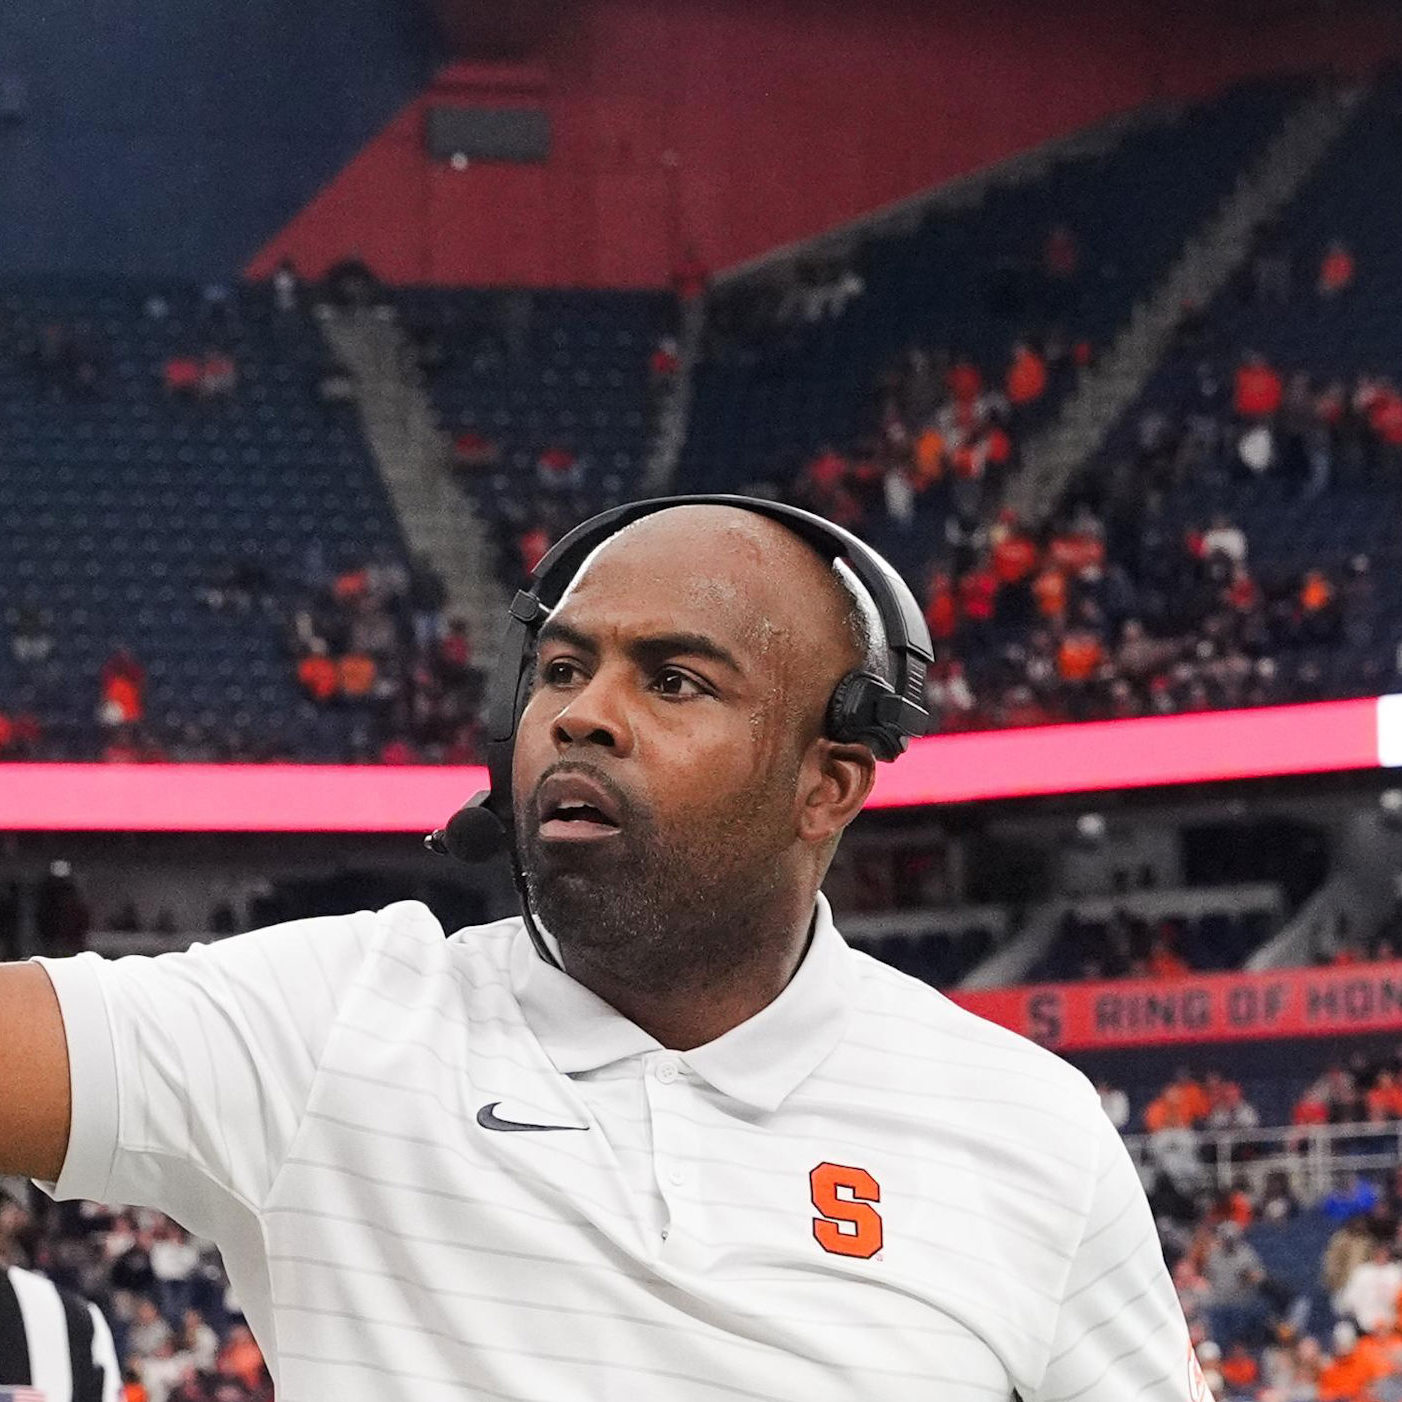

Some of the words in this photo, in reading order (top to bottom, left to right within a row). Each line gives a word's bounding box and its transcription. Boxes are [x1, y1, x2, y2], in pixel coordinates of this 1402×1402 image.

[1026, 992, 1065, 1046] S
[1094, 988, 1211, 1037] RING
[1228, 983, 1286, 1028] OF
[809, 1161, 883, 1260] S
